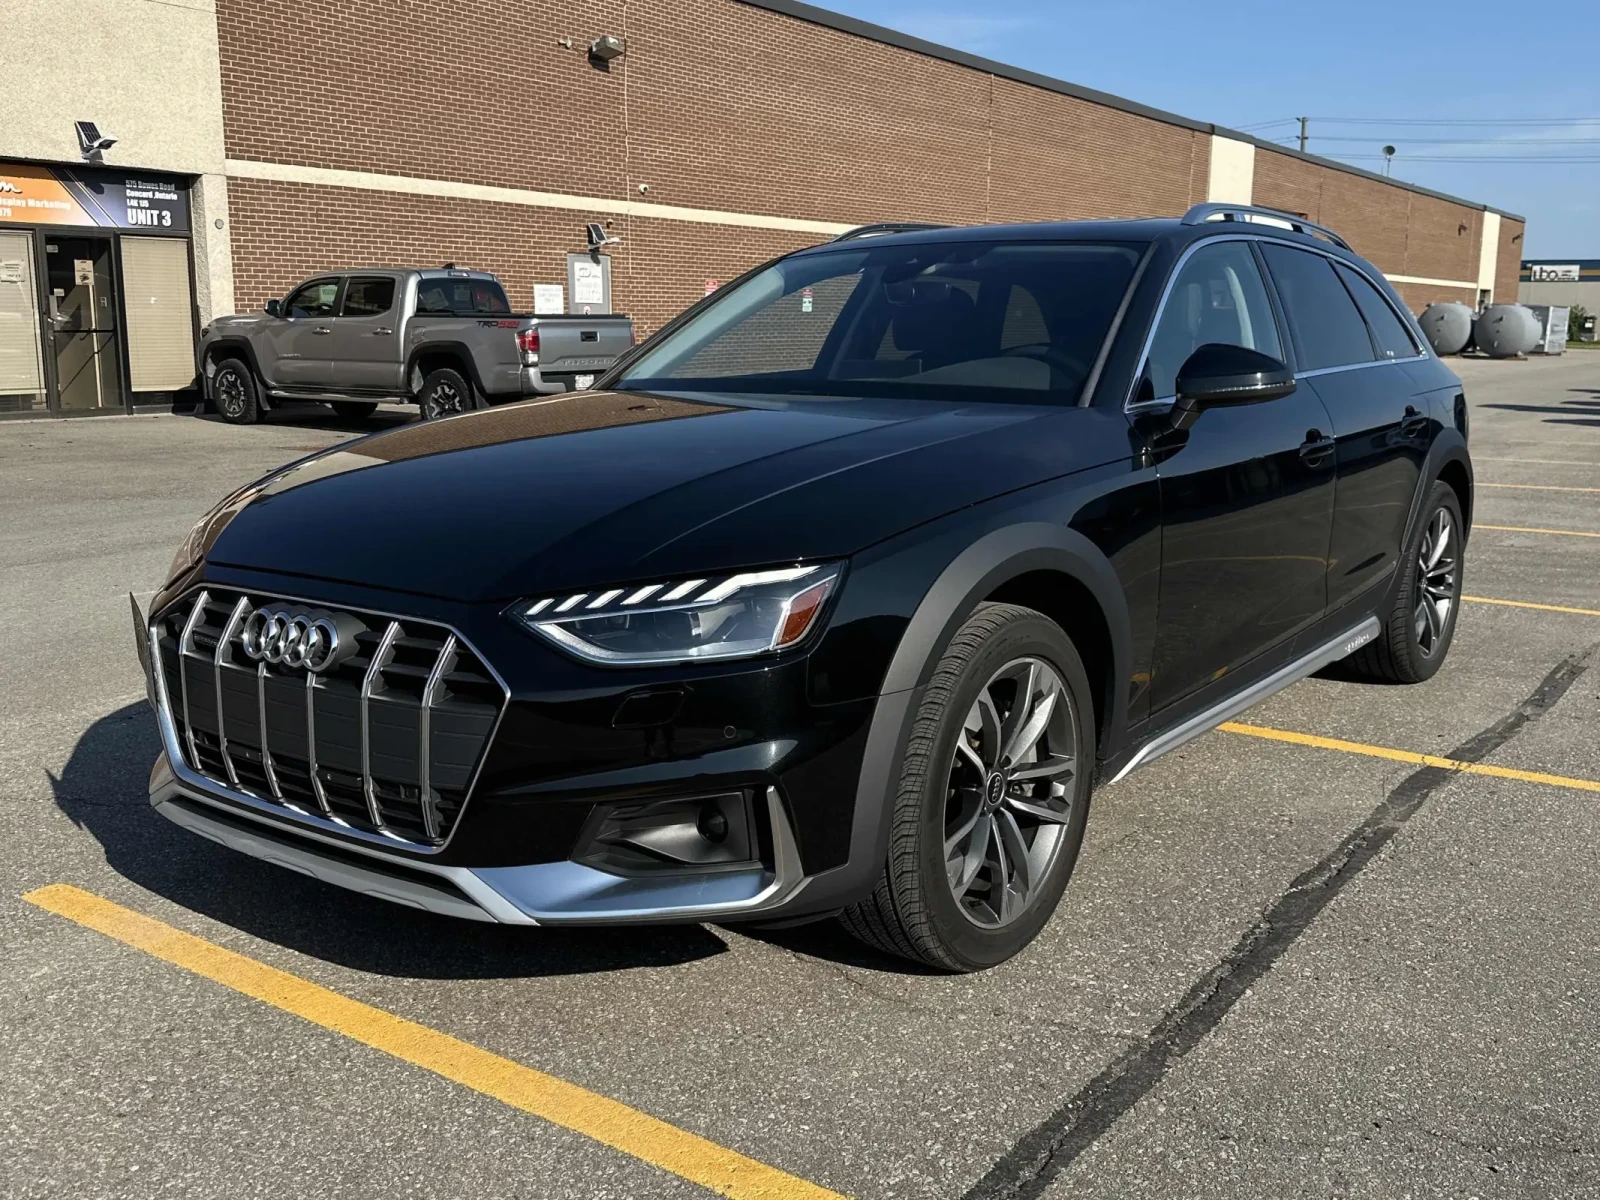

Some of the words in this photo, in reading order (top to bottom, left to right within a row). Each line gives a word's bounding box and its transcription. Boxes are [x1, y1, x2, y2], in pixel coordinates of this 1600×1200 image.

[159, 182, 176, 191] Road
[126, 189, 153, 199] Concord
[27, 198, 72, 211] Marketing
[127, 208, 160, 226] UNIT
[161, 210, 172, 227] 3
